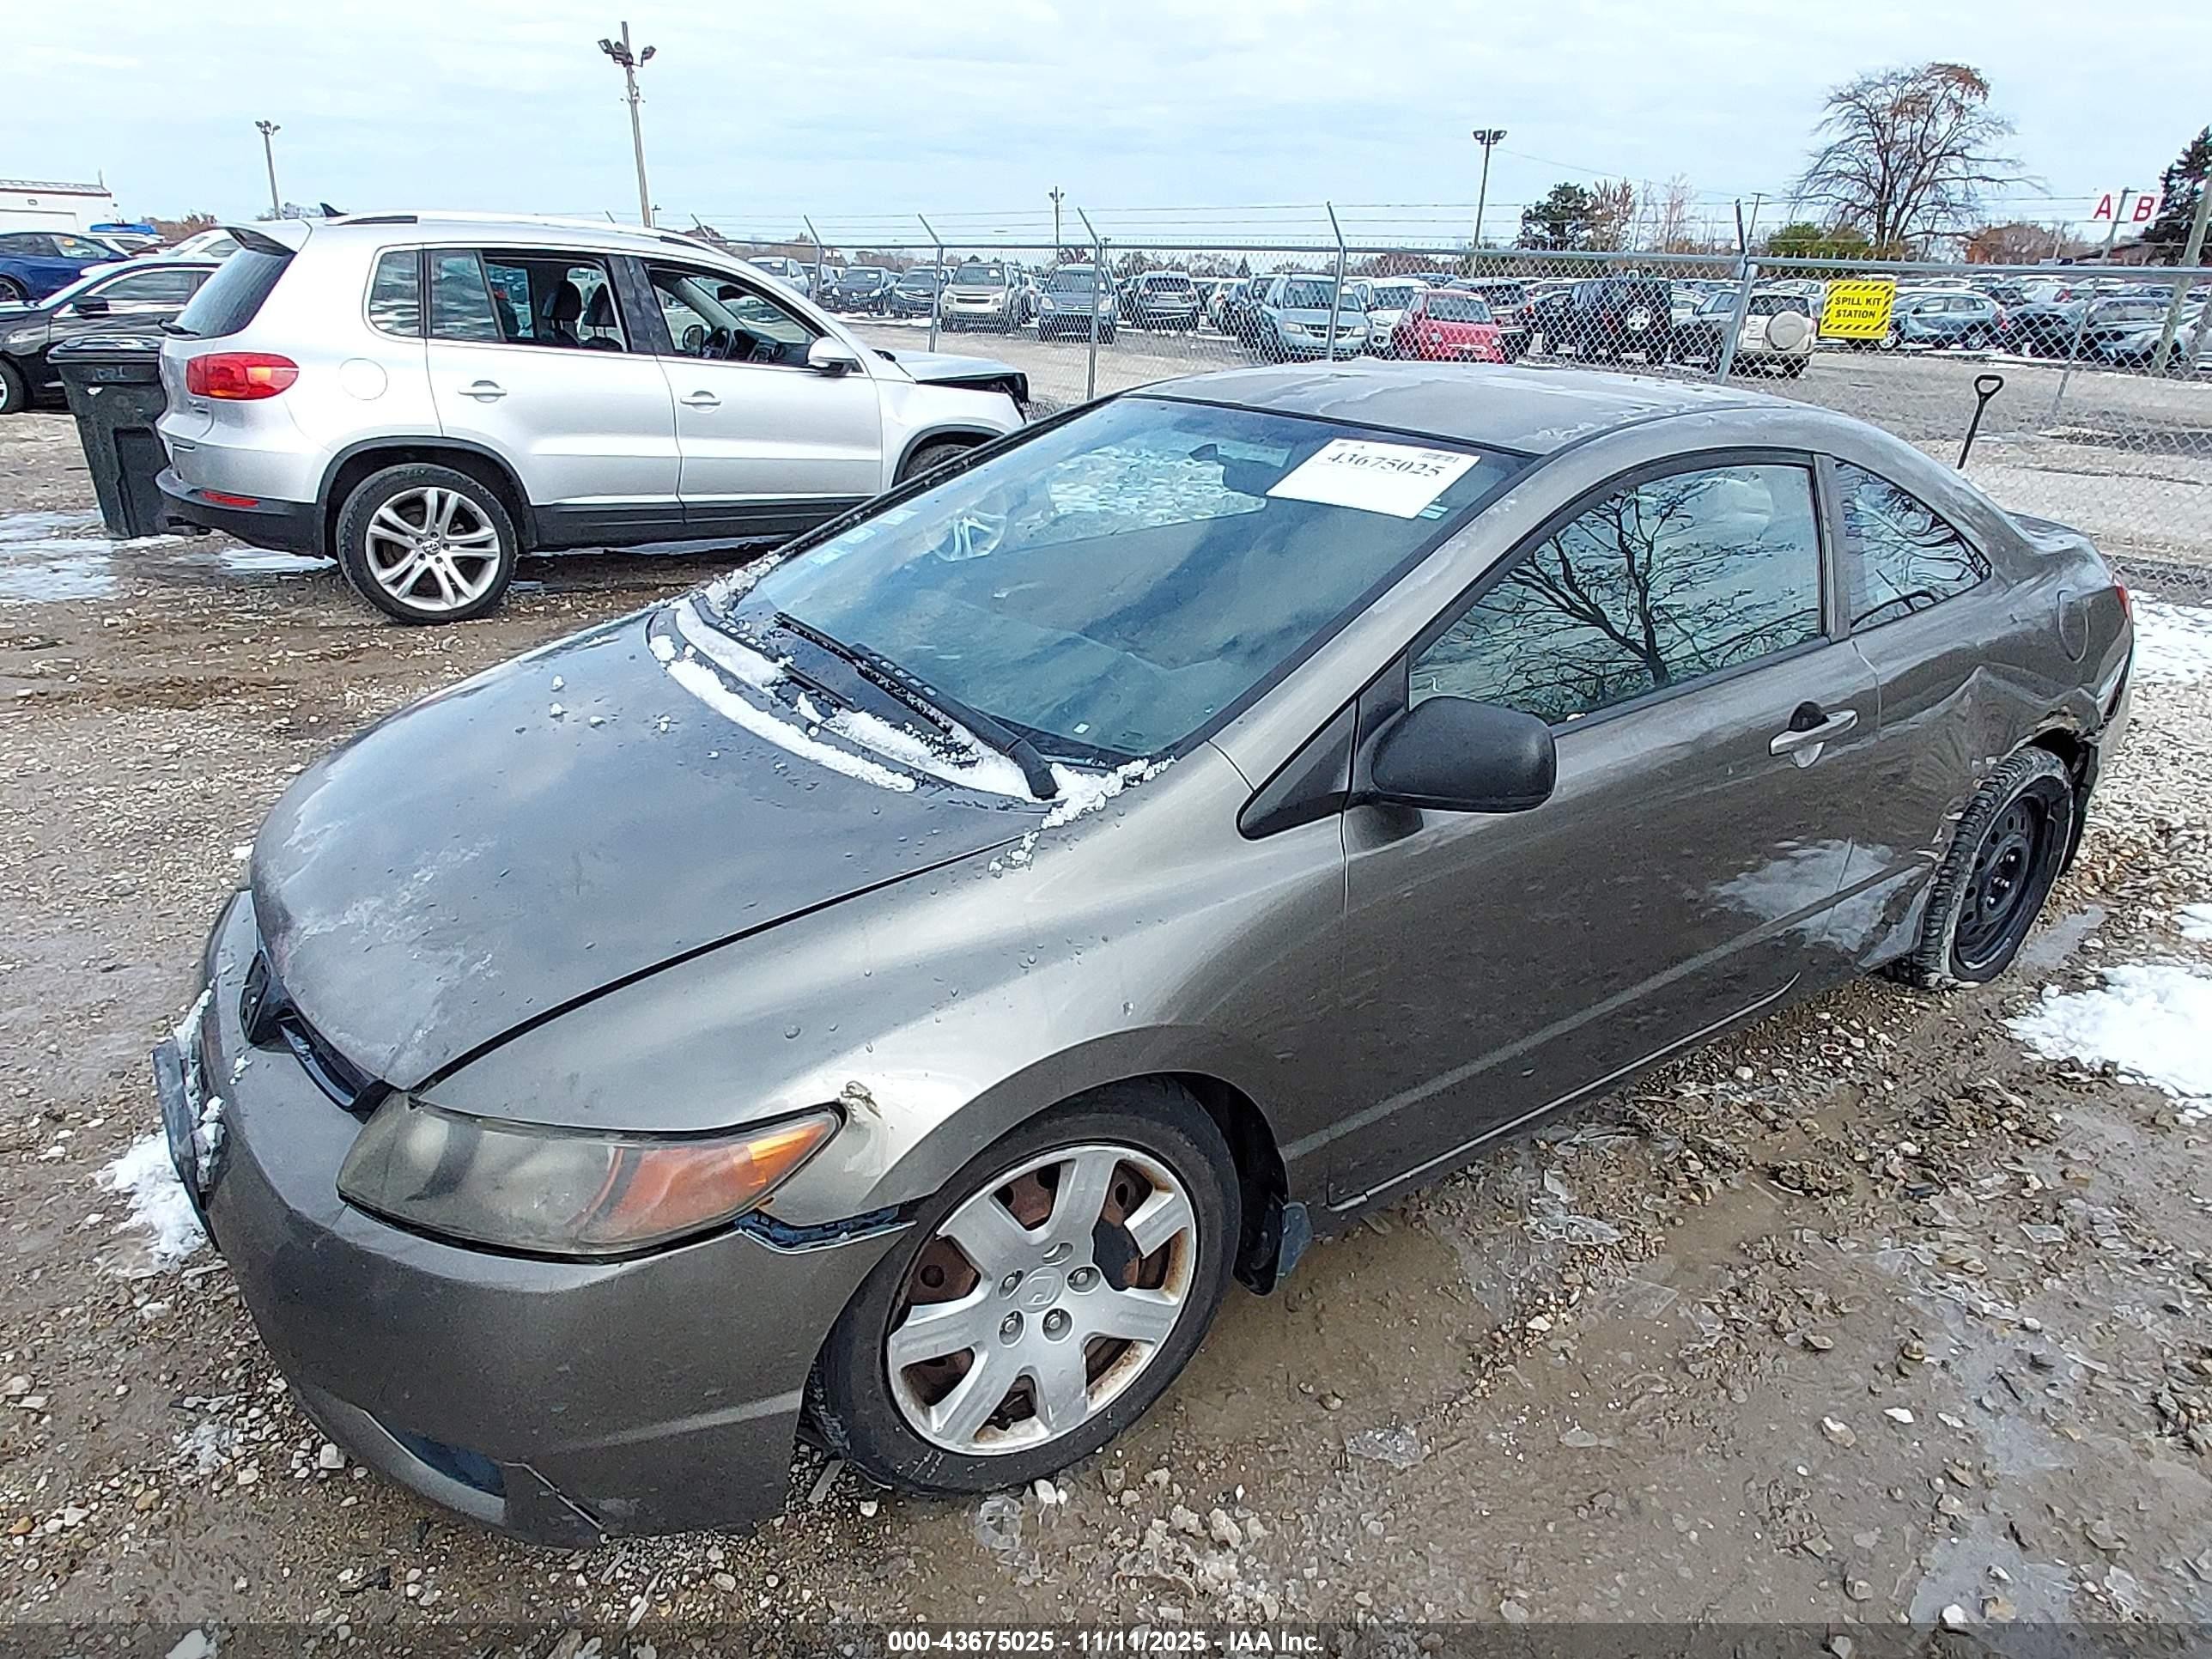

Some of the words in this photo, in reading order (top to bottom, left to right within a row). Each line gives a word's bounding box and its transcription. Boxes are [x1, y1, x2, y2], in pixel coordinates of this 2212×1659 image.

[2093, 193, 2112, 220] A
[2132, 195, 2155, 222] B
[1834, 296, 1862, 306] SPILL
[1865, 297, 1882, 307] KIT
[1835, 309, 1876, 319] STATION
[1328, 452, 1446, 477] 43675025
